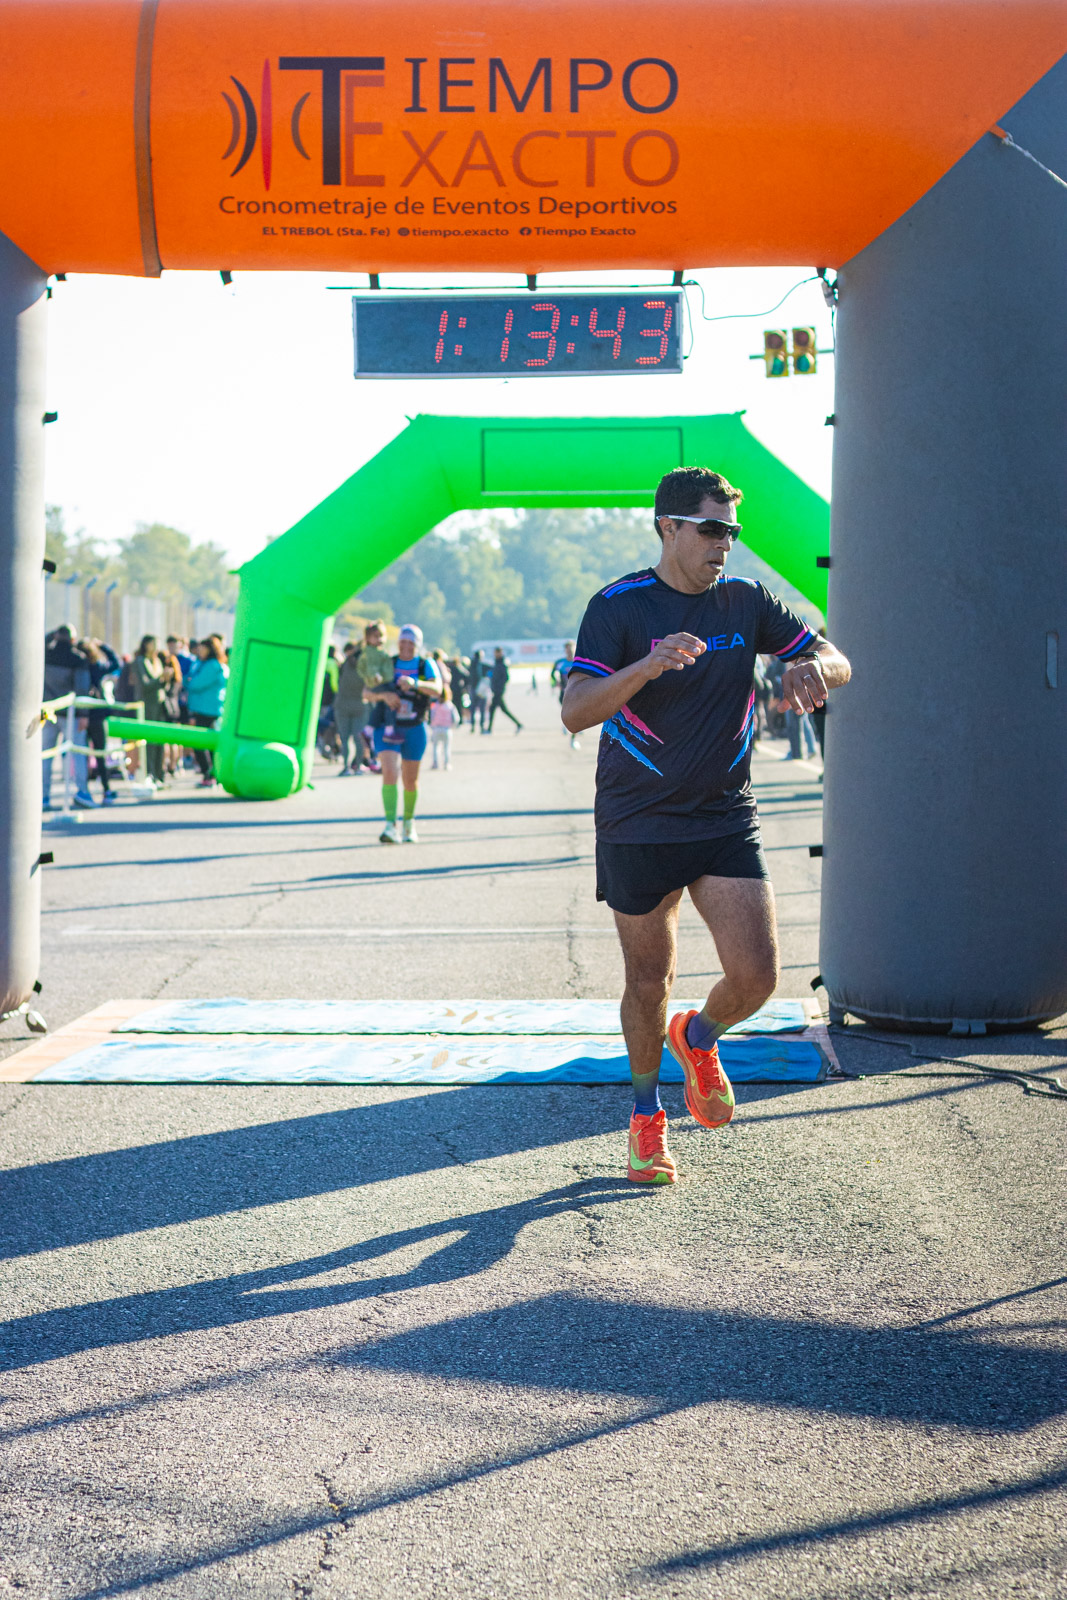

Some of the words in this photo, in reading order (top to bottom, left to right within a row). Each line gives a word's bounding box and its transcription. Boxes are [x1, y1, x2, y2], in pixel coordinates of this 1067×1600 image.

[218, 196, 388, 219] Cronometraje
[394, 196, 425, 215] de
[432, 196, 531, 215] Eventos
[538, 196, 678, 218] Deportivos
[262, 226, 278, 236] EL
[280, 226, 334, 236] TREBOL
[336, 226, 368, 238] (Sta.
[370, 226, 391, 238] Fe)
[411, 226, 510, 238] tiempo.exacto
[533, 226, 587, 238] Tiempo
[589, 226, 637, 237] Exacto
[434, 300, 673, 367] 1:13:43
